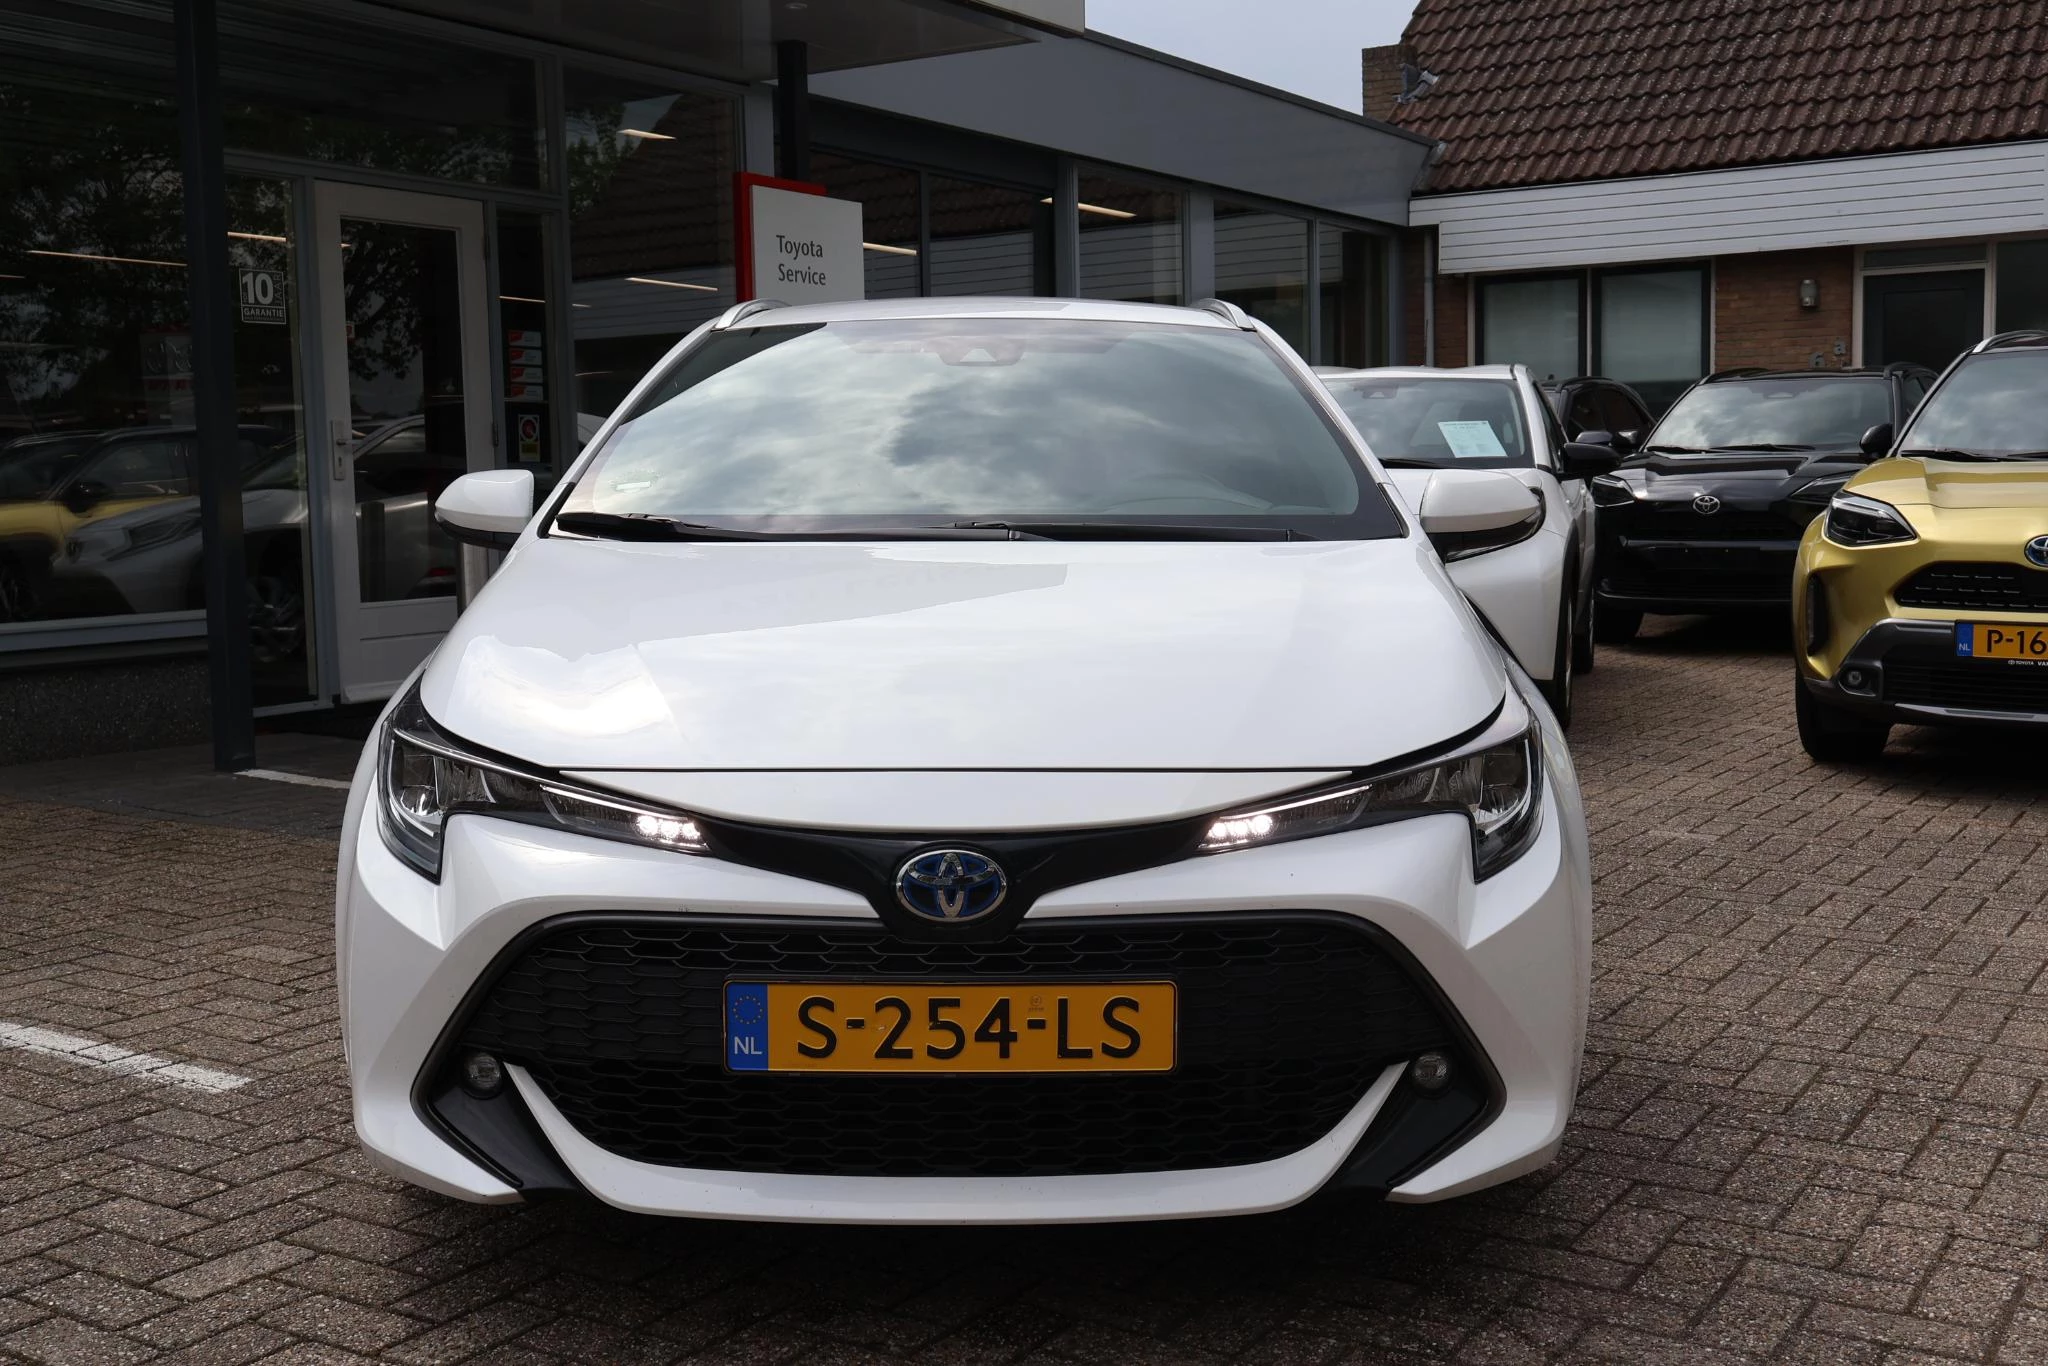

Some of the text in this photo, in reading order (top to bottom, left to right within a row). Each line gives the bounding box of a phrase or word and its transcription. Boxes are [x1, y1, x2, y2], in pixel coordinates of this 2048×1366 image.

[776, 234, 823, 260] Toyota
[778, 263, 826, 286] Service
[242, 272, 273, 304] 10
[243, 308, 284, 317] GARANTIE
[1958, 643, 1970, 651] NL
[797, 995, 1141, 1060] S-254-LS
[733, 1036, 763, 1056] NL
